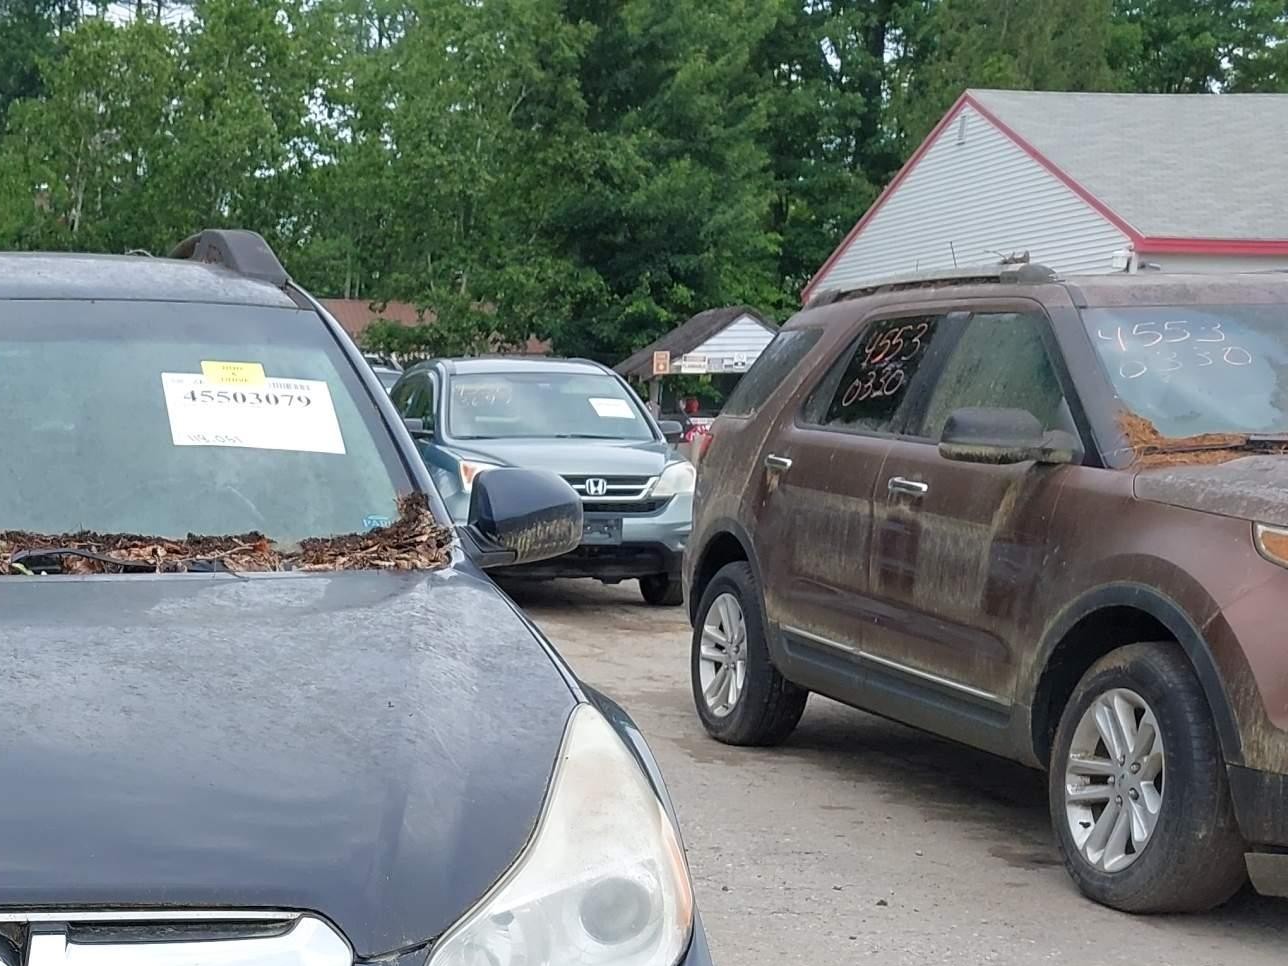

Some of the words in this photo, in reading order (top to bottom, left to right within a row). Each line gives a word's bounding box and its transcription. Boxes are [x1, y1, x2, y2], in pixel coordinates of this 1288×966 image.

[860, 322, 929, 369] 4553
[1098, 320, 1226, 352] 4553
[1119, 346, 1253, 379] 0330
[183, 389, 312, 407] 45503079
[841, 367, 905, 407] 0330
